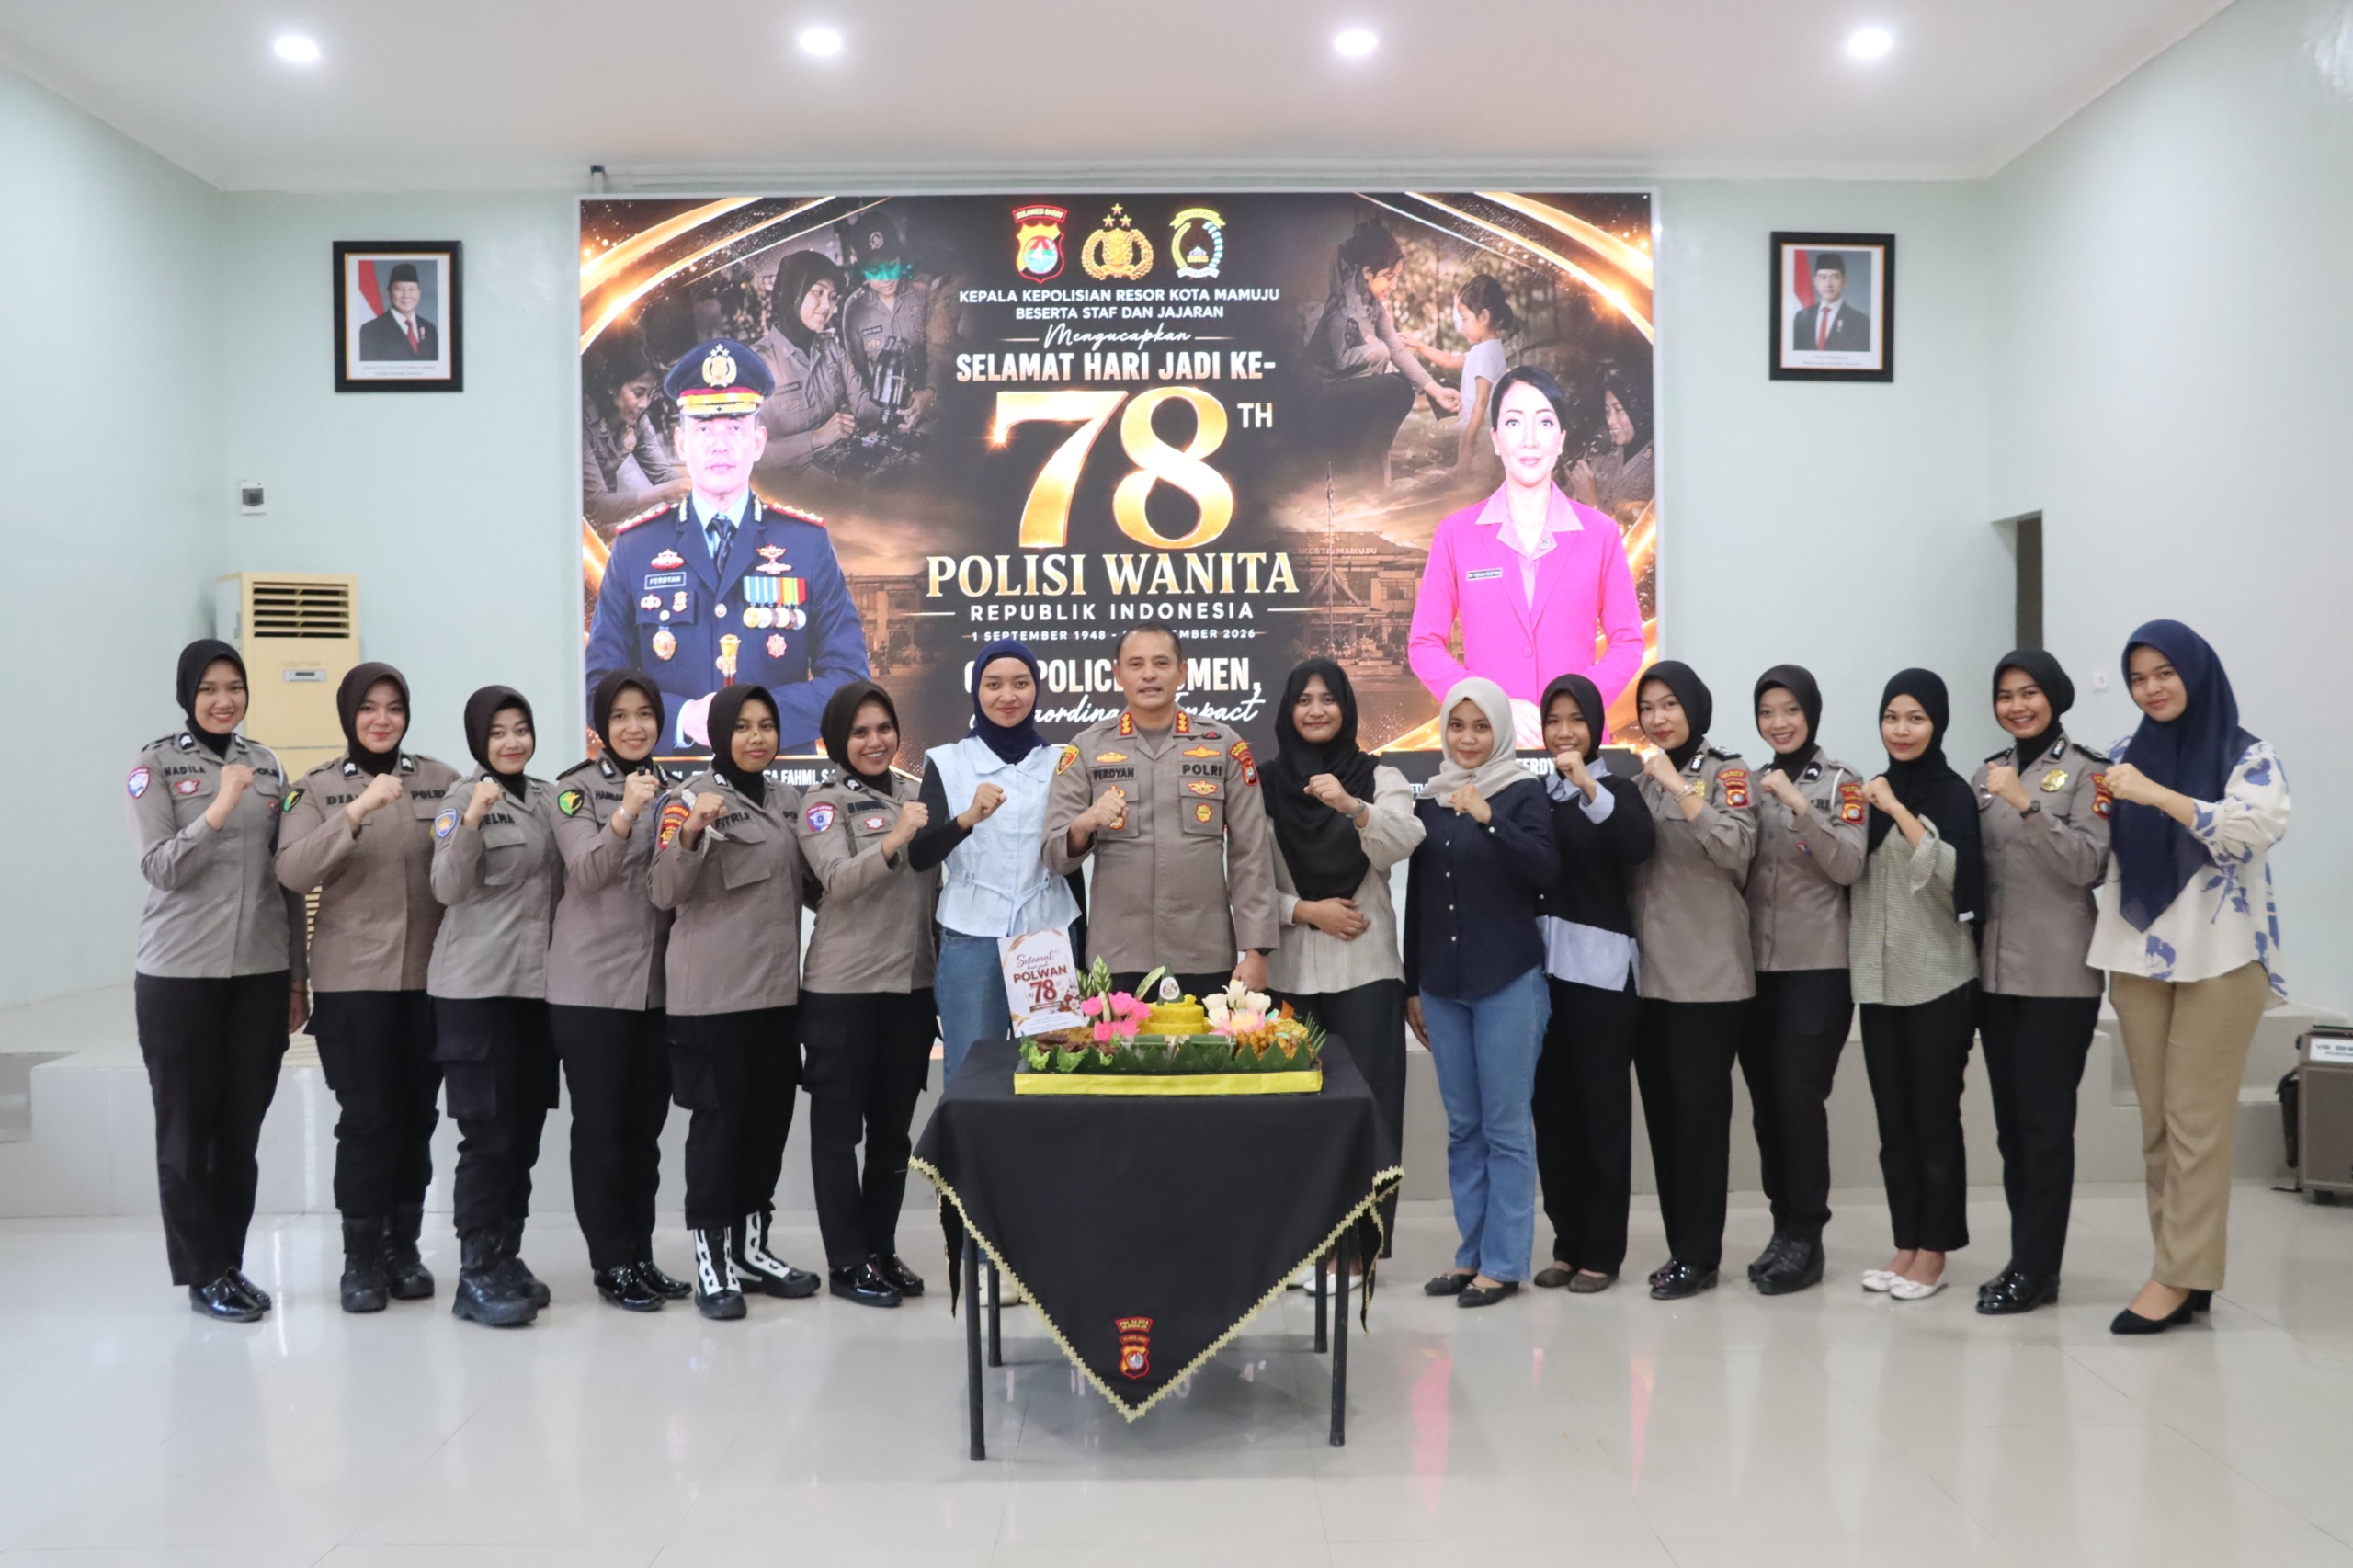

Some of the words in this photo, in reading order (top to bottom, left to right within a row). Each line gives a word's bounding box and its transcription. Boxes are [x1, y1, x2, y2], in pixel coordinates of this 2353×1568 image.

[959, 290, 1017, 302] KEPALA
[1022, 289, 1111, 302] KEPOLISIAN
[1116, 289, 1165, 301] RESOR
[1169, 288, 1210, 301] KOTA
[1214, 288, 1279, 301] MAMUJU
[1016, 307, 1078, 320] BESERTA
[1082, 306, 1118, 319] STAF
[1121, 306, 1154, 319] DAN
[1157, 305, 1224, 318] JAJARAN
[1043, 322, 1191, 351] Mengucapkan
[956, 352, 1074, 382] SELAMAT
[1084, 351, 1150, 381] HARI
[1158, 351, 1221, 380] JADI
[1230, 351, 1276, 380] KE-
[995, 385, 1234, 550] 78
[1237, 403, 1273, 428] TH
[926, 553, 1087, 597] POLISI
[1103, 552, 1300, 596] WANITA
[971, 603, 1097, 621] REPUBLIK
[1110, 602, 1254, 620] INDONESIA
[972, 631, 978, 642] 1
[983, 630, 1068, 642] SEPTEMBER
[1074, 630, 1107, 641] 1948
[1222, 628, 1256, 639] 2026
[164, 766, 207, 777] NADILA
[1093, 767, 1135, 780] FERDYAN
[1182, 764, 1222, 777] POLRI
[1017, 949, 1056, 968] Selamat
[1013, 964, 1068, 983] POLWAN
[1029, 979, 1058, 1005] 78
